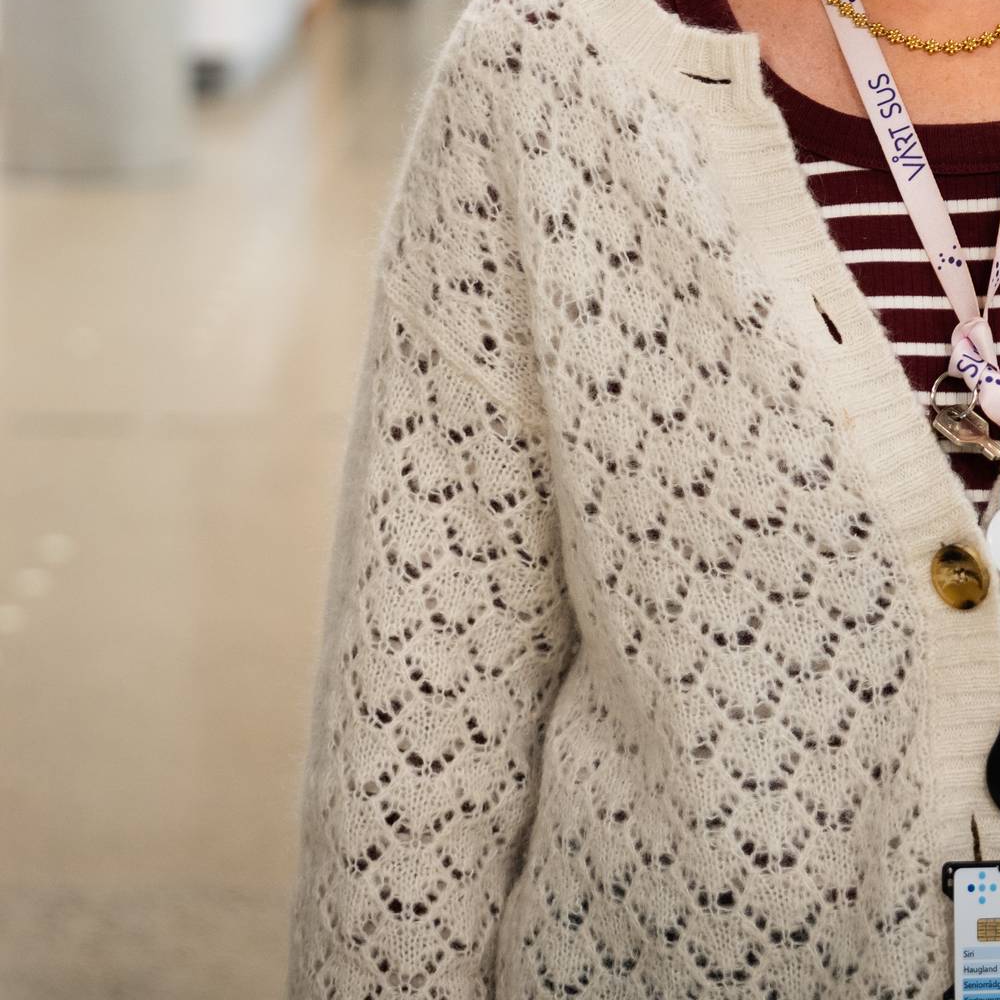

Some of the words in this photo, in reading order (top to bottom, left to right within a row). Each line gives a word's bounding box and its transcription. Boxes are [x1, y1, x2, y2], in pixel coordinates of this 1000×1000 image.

[868, 73, 902, 119] SUS
[888, 125, 926, 182] VÅRT
[963, 950, 975, 958] Siri
[963, 965, 998, 975] Haugland
